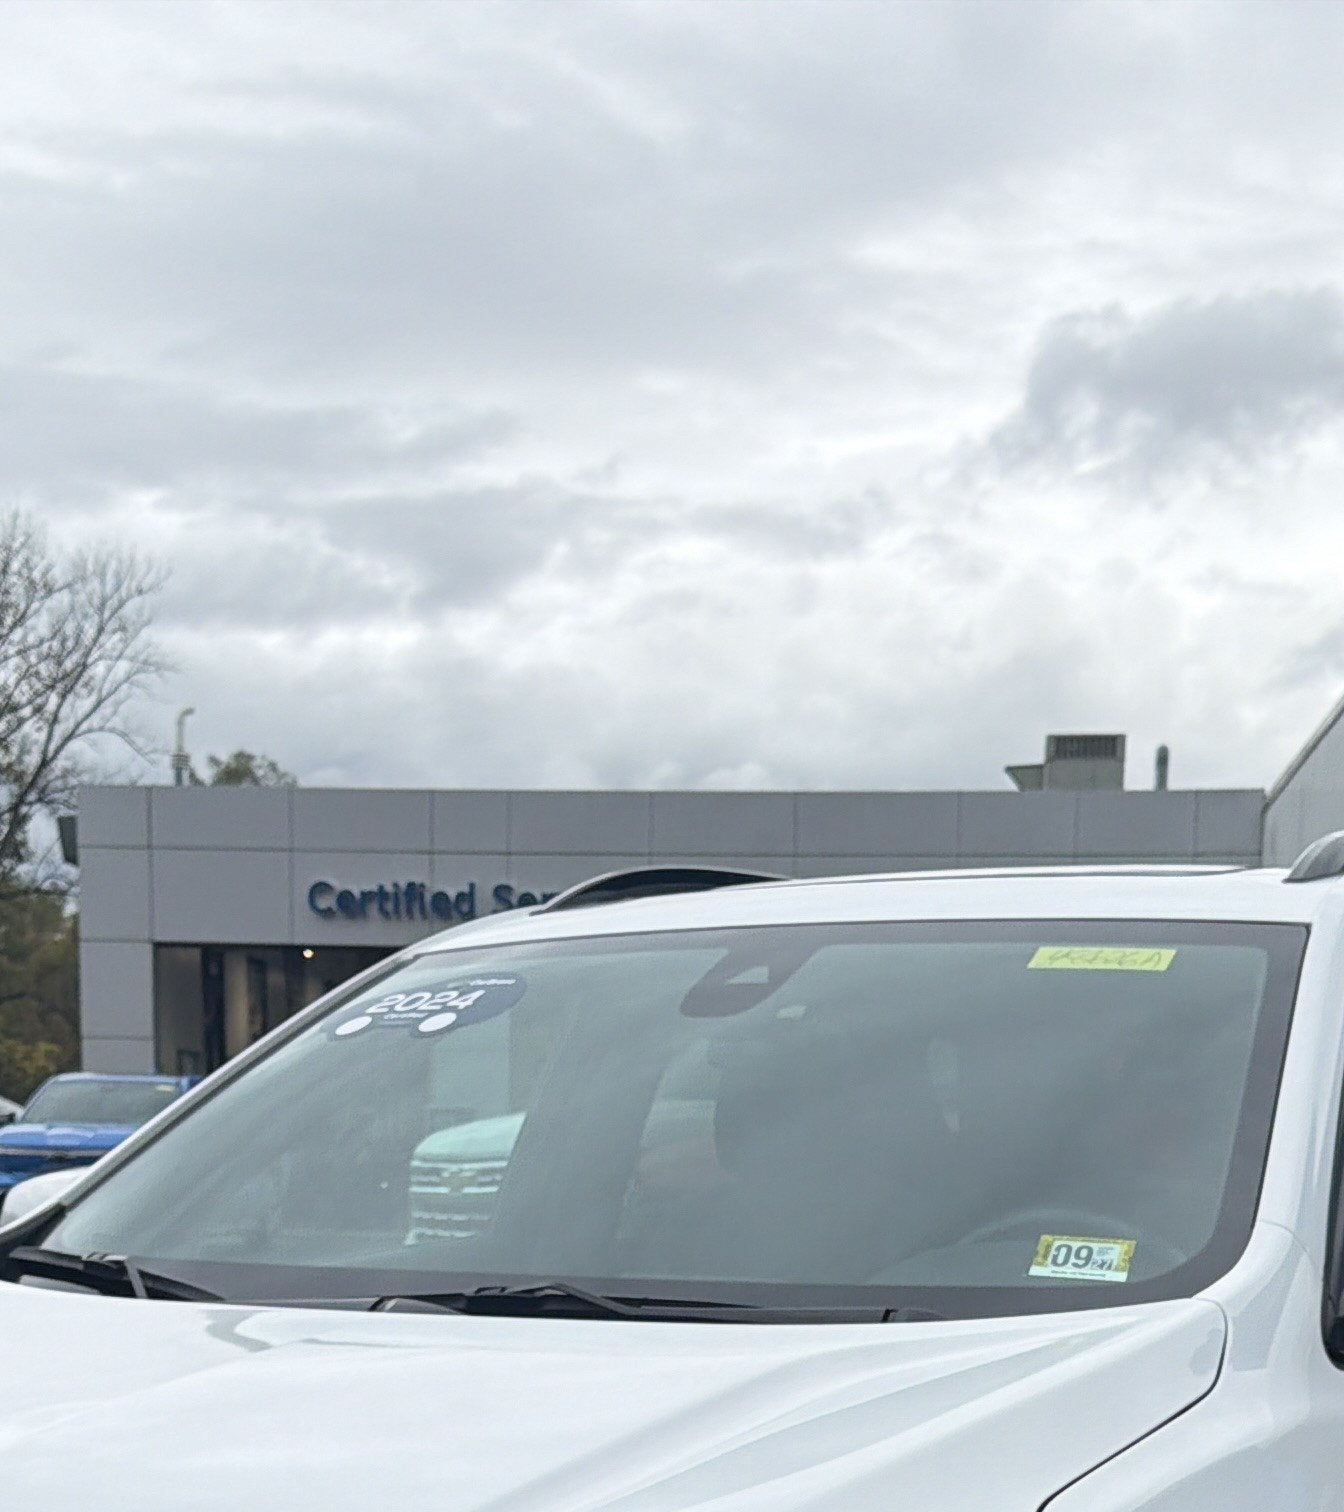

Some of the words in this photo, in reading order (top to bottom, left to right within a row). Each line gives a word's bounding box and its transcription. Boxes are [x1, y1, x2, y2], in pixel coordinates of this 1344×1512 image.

[307, 880, 477, 922] Certified
[365, 989, 486, 1014] 2024
[1050, 1243, 1094, 1269] 09
